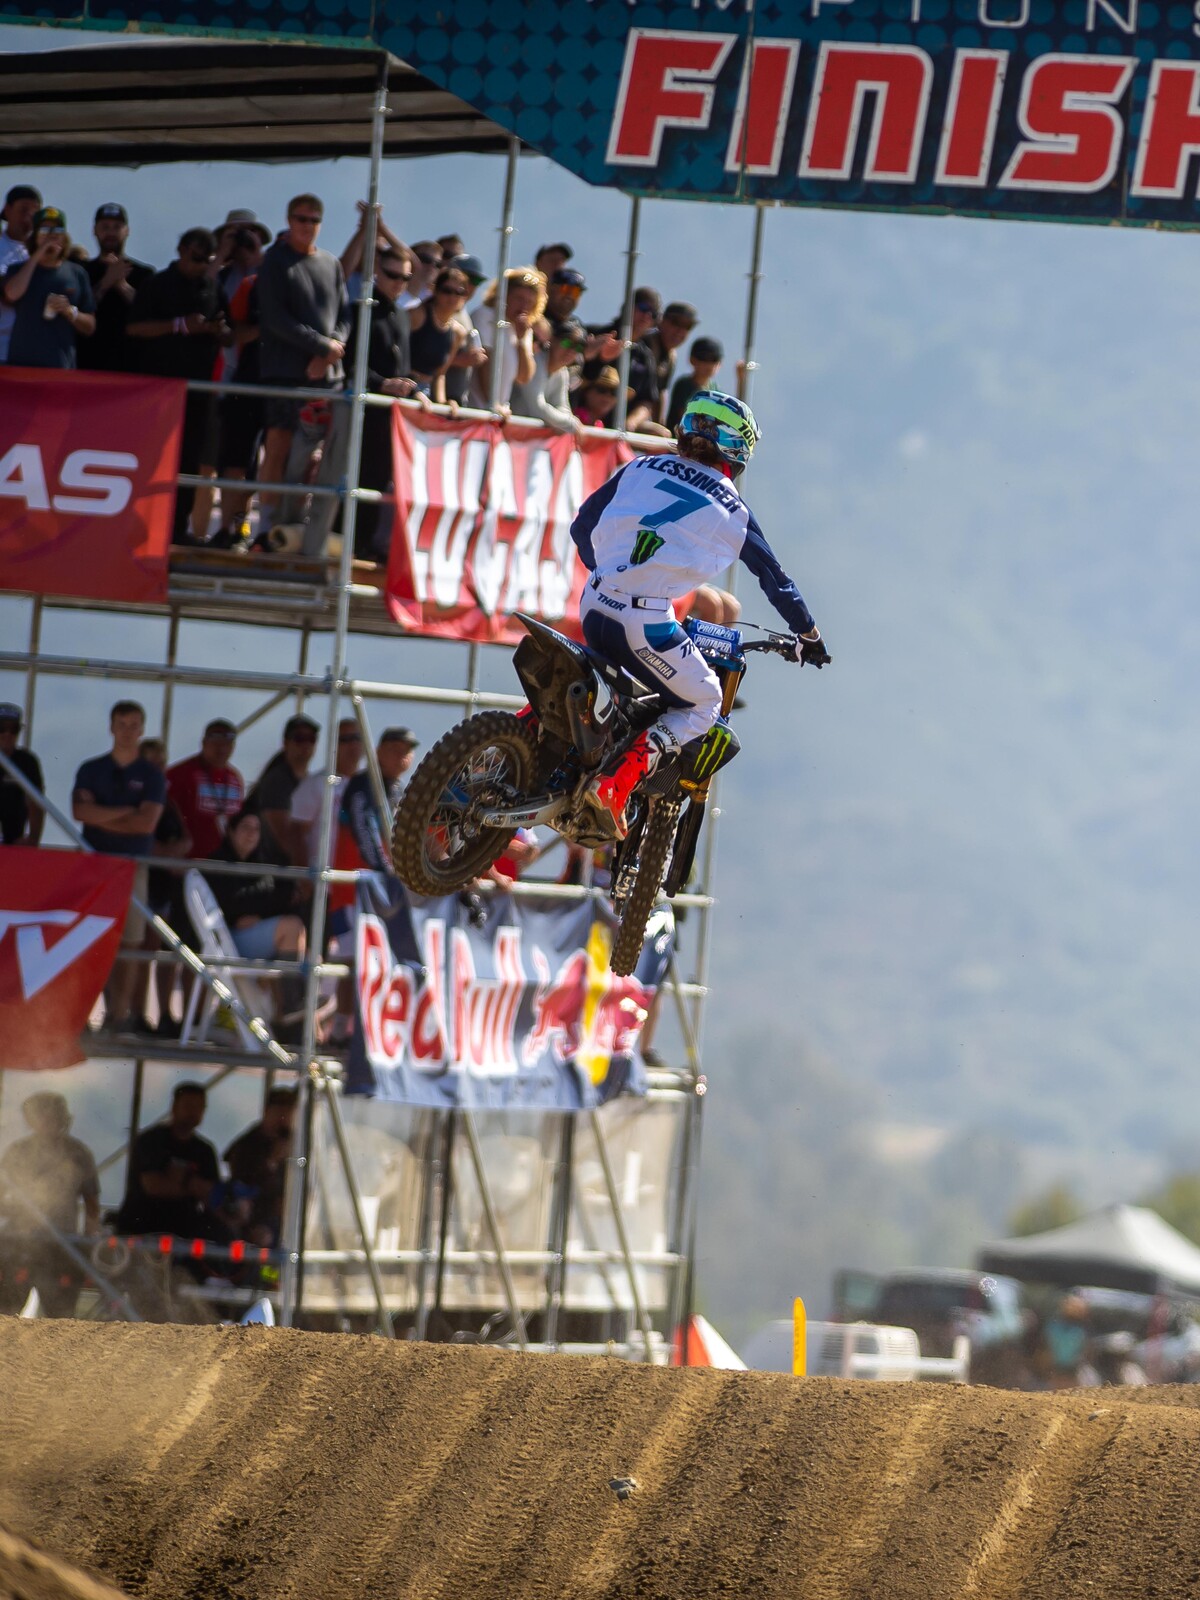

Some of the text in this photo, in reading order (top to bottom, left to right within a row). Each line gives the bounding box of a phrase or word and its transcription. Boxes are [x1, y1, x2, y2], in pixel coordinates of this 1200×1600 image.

[0, 443, 139, 516] AS
[635, 454, 742, 515] PLESSINGER
[638, 478, 712, 529] 7
[406, 438, 584, 619] LUCAS
[597, 592, 627, 612] THOR
[695, 636, 732, 653] PROTAPER
[699, 623, 733, 641] PROTAPER
[645, 652, 674, 679] YAMAHA
[357, 913, 527, 1077] Red Bull
